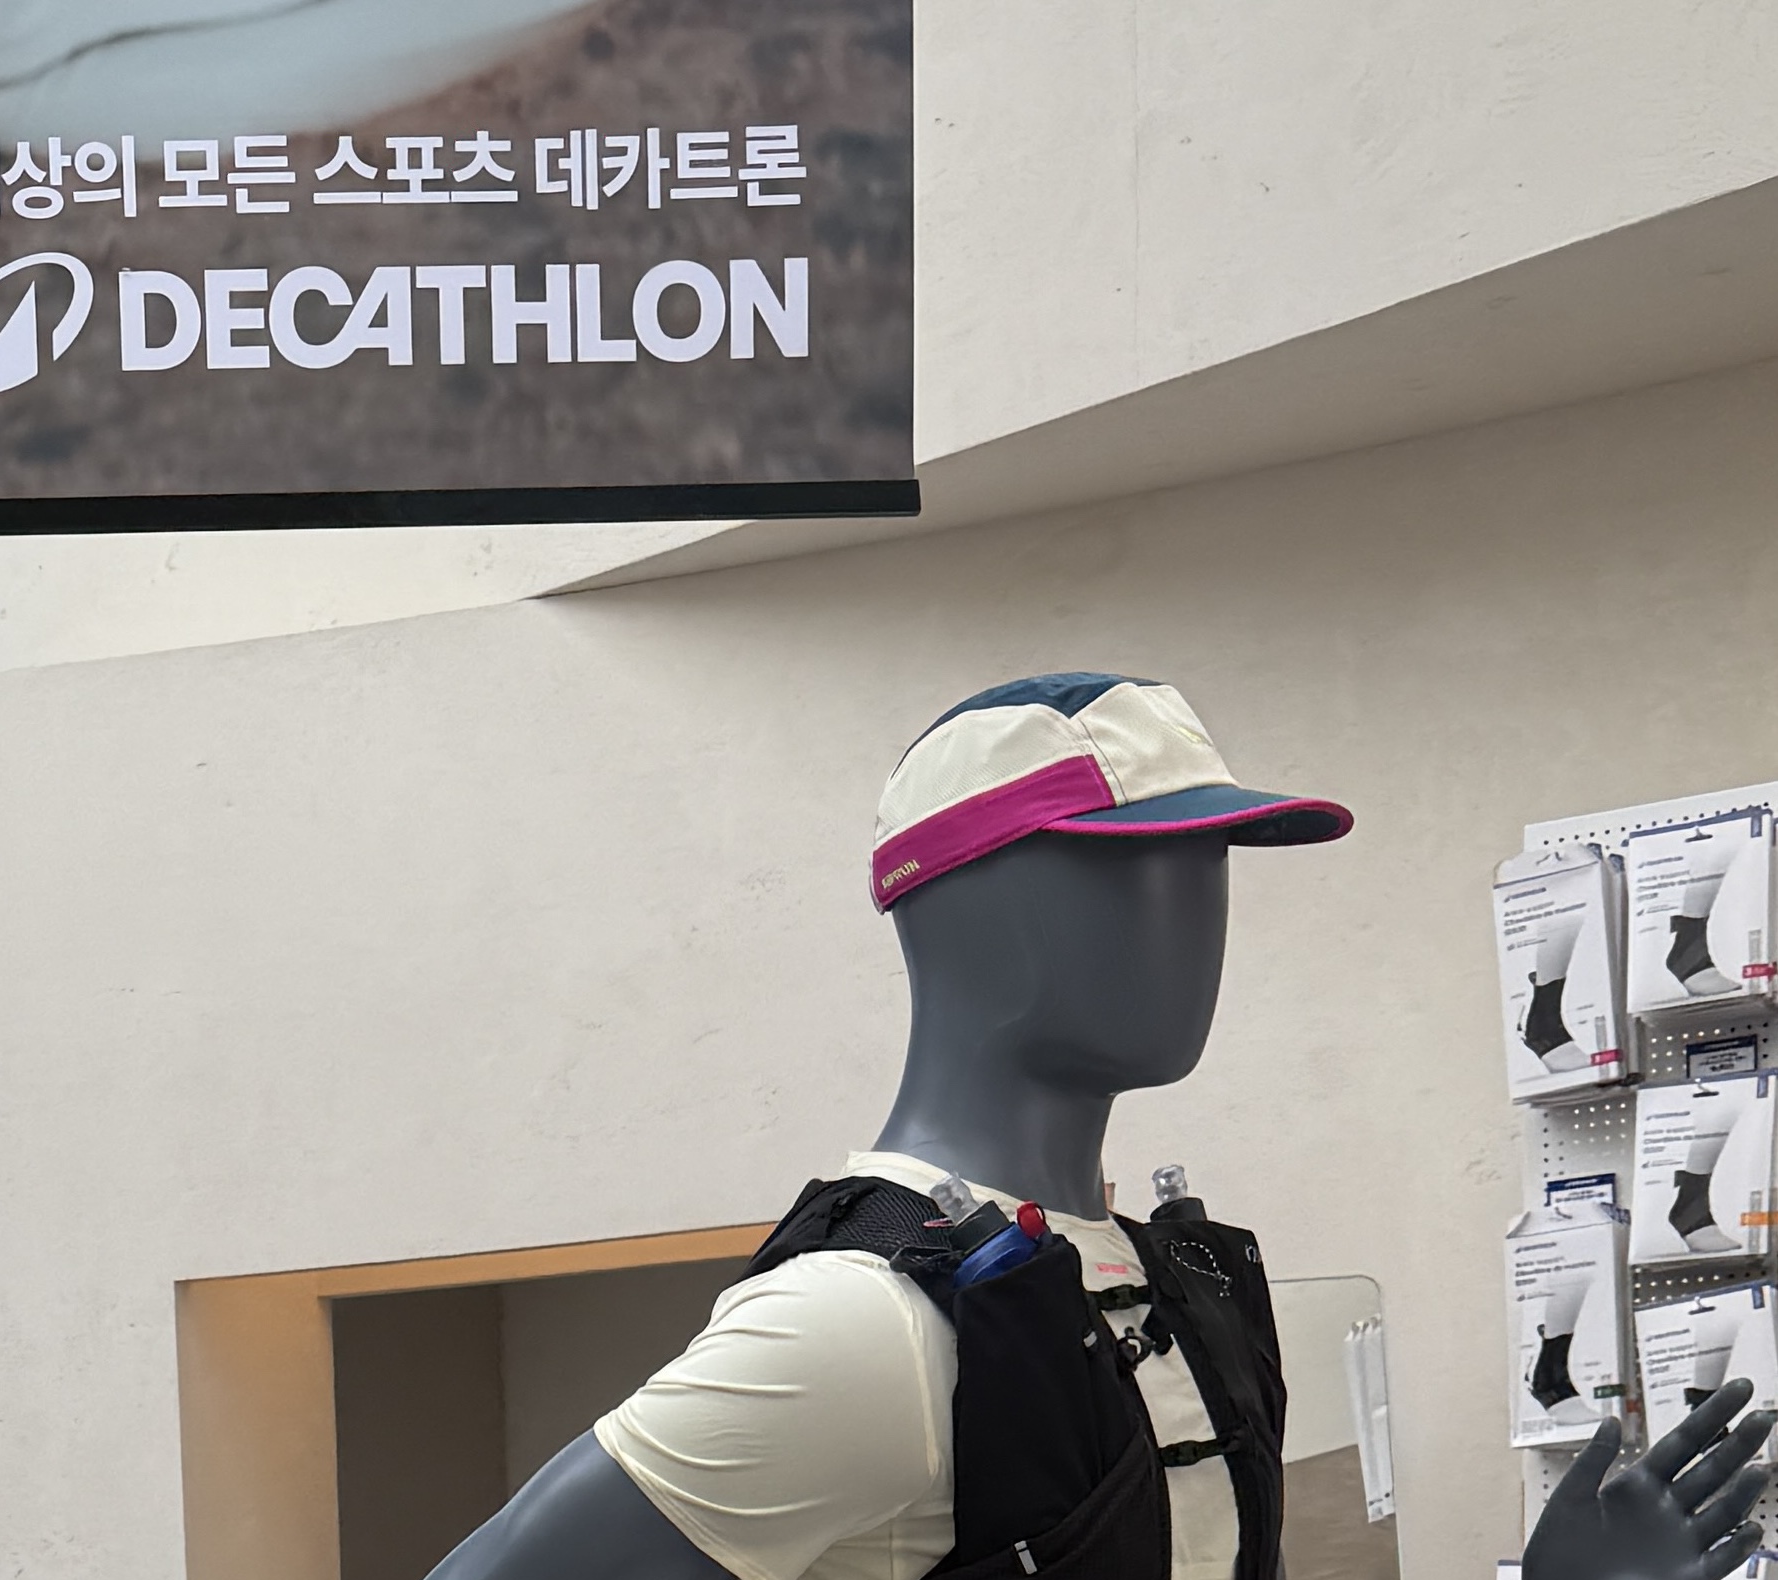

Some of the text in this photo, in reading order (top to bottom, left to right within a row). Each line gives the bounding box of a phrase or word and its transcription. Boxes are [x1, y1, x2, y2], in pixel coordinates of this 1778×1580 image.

[157, 134, 297, 215] 모든
[312, 130, 519, 205] 스포츠
[534, 124, 808, 210] 데카트론
[118, 257, 810, 372] DECATHLON
